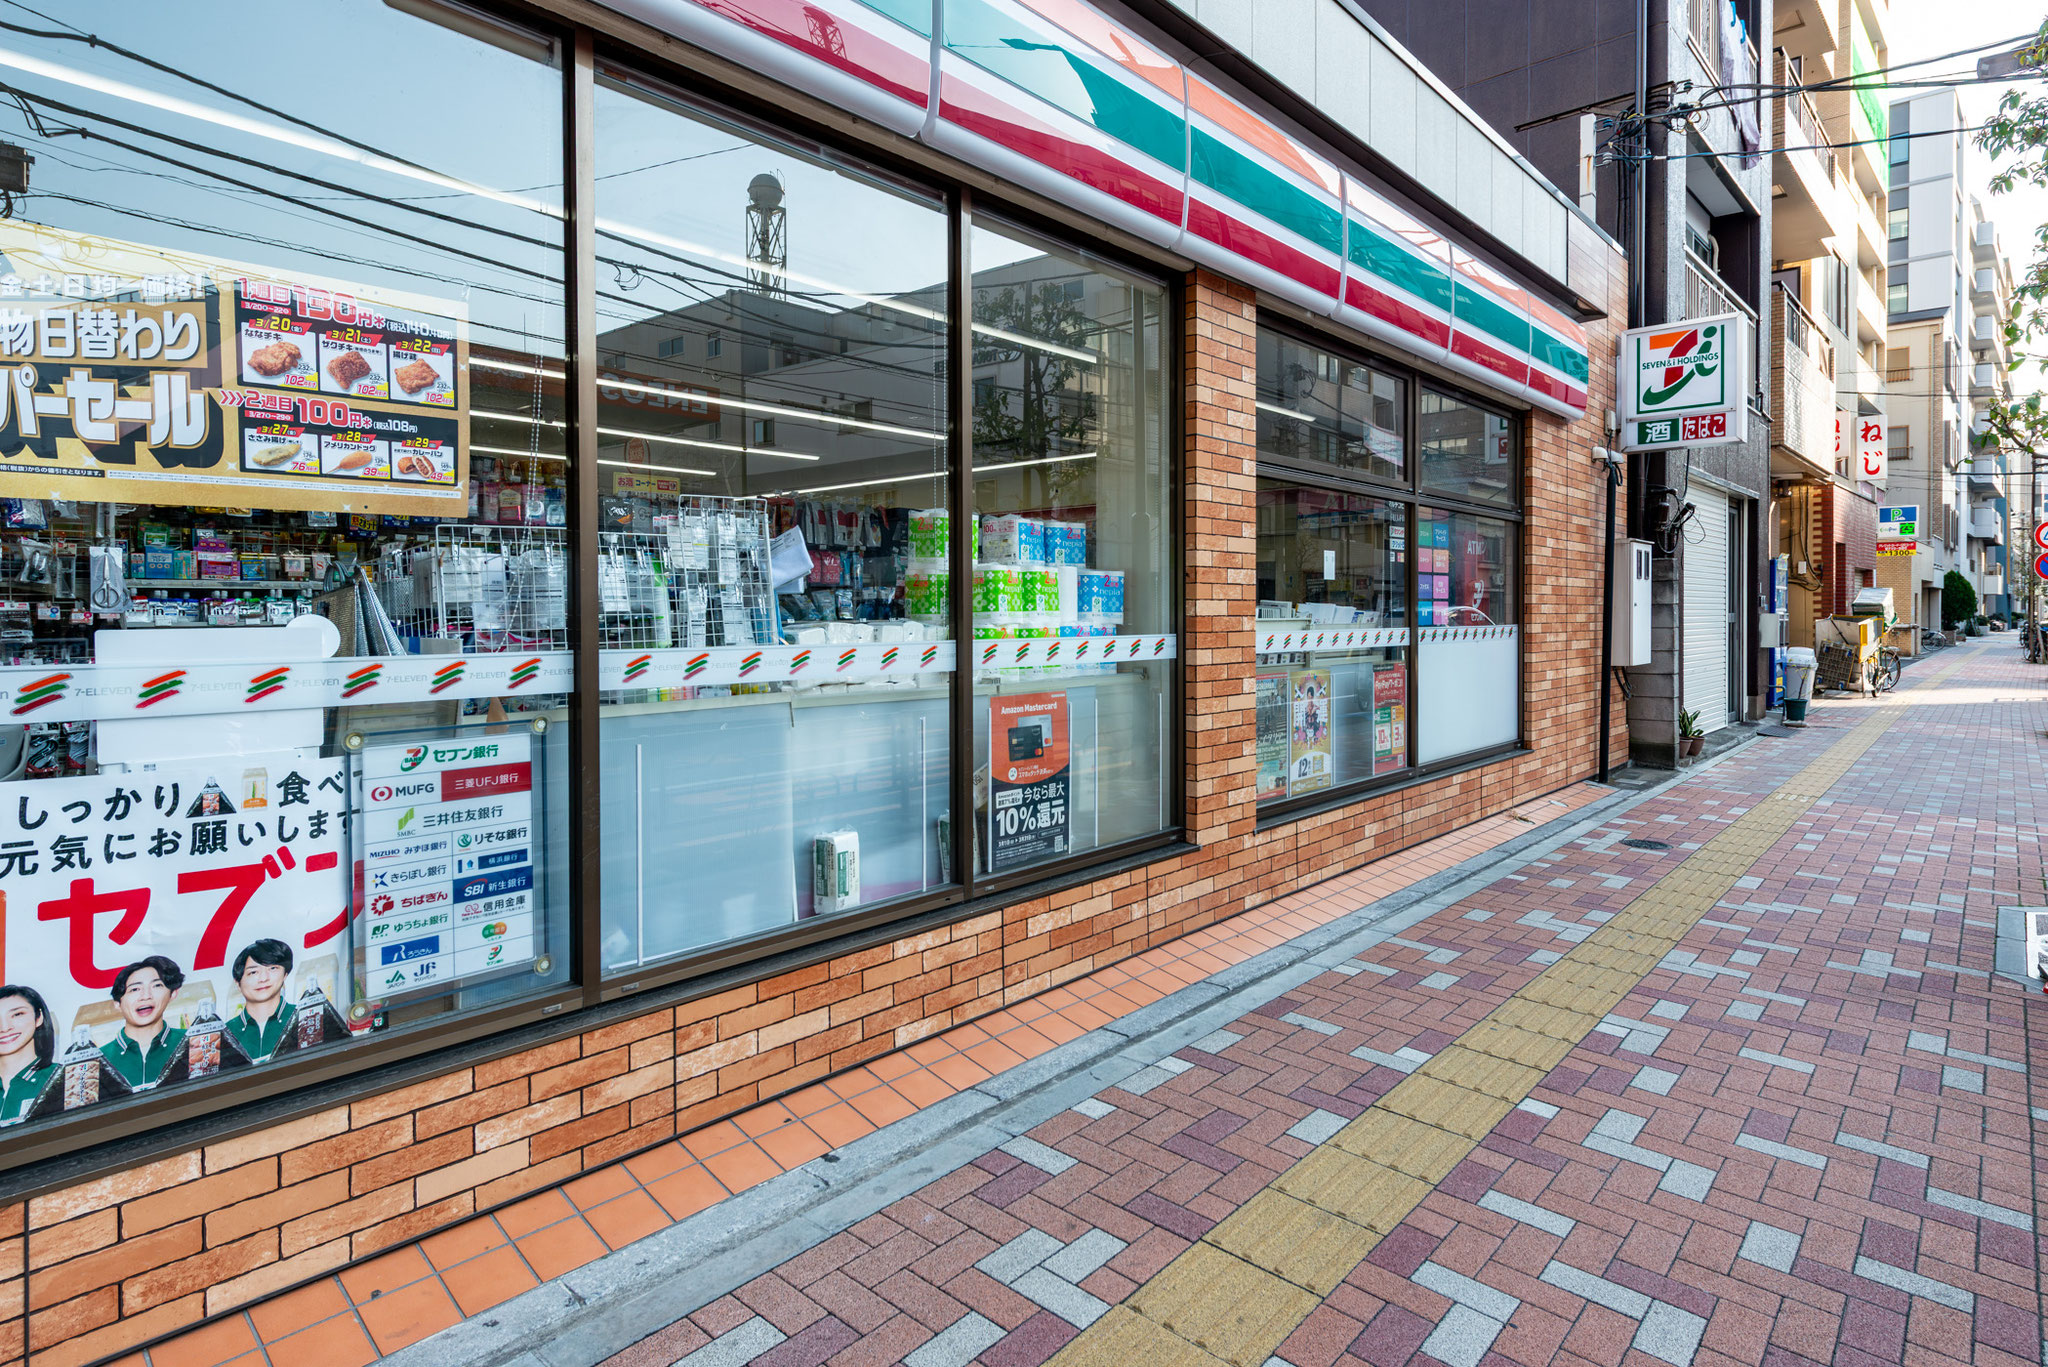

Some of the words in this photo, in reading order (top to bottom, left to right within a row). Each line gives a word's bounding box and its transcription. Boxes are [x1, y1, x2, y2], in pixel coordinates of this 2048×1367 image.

[245, 328, 281, 341] ななチキ
[1677, 352, 1719, 365] HOLDINGS
[245, 390, 293, 411] 2週目
[1645, 421, 1671, 443] 酒
[1684, 415, 1725, 439] たばこ
[324, 441, 376, 452] アメリカンドッグ
[412, 449, 443, 457] カレーパン
[1861, 420, 1883, 475] ねじ
[636, 479, 656, 487] コーナー
[1891, 508, 1903, 521] P
[1063, 540, 1083, 548] nepia
[1466, 540, 1483, 555] ATM
[1100, 588, 1120, 596] nepia
[1001, 706, 1024, 715] Amazon
[1024, 701, 1058, 712] Mastercard
[433, 744, 498, 764] セブン銀行
[455, 773, 519, 790] 三菱UFJ銀行
[395, 782, 435, 798] MUFG
[1024, 780, 1065, 804] 今なら最大
[19, 782, 181, 830] しっかり
[423, 805, 503, 828] 三井住友銀行
[996, 799, 1065, 837] 10%還元
[397, 829, 416, 838] SMBC
[475, 827, 528, 845] りそな銀行
[369, 848, 400, 858] MIZUHO
[404, 840, 448, 856] みずほ銀行
[488, 853, 518, 864] 横浜銀行
[390, 864, 447, 883] きらぼし銀行
[464, 883, 485, 897] SBI
[488, 876, 526, 892] 新生銀行
[401, 890, 448, 908] ちばぎん
[483, 895, 526, 912] 信用金庫
[37, 846, 365, 990] セブン
[393, 914, 449, 933] ゆうちょ銀行
[407, 947, 433, 959] ろうきん
